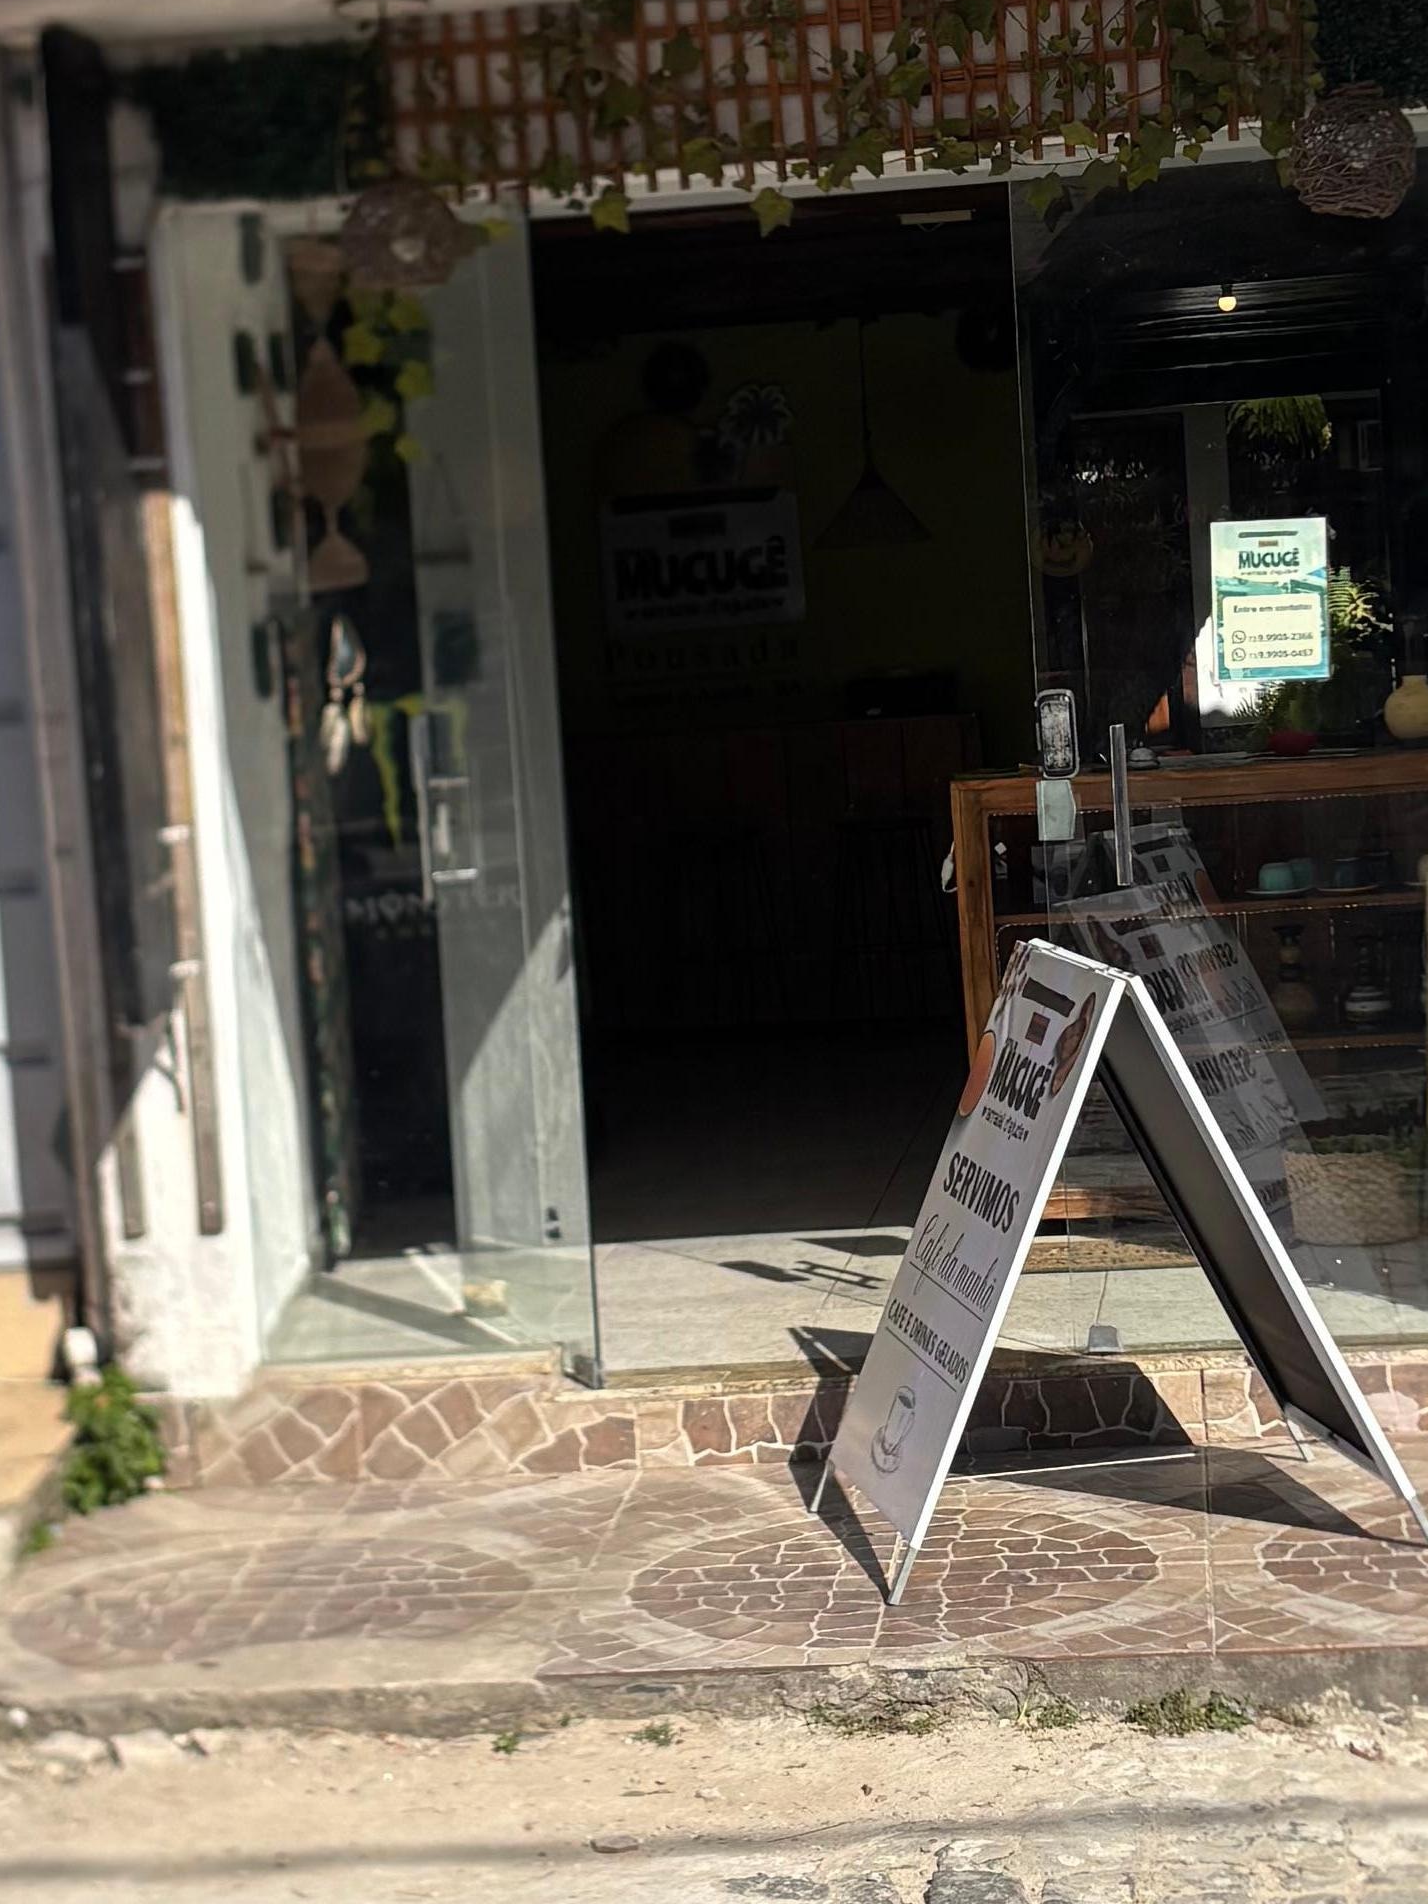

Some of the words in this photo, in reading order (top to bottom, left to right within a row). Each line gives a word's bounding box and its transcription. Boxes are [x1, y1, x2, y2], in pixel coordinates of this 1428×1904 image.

[1238, 547, 1300, 569] MUCUGÊ
[987, 1036, 1056, 1121] MUCUGÊ
[943, 1151, 1021, 1234] SERVIMOS
